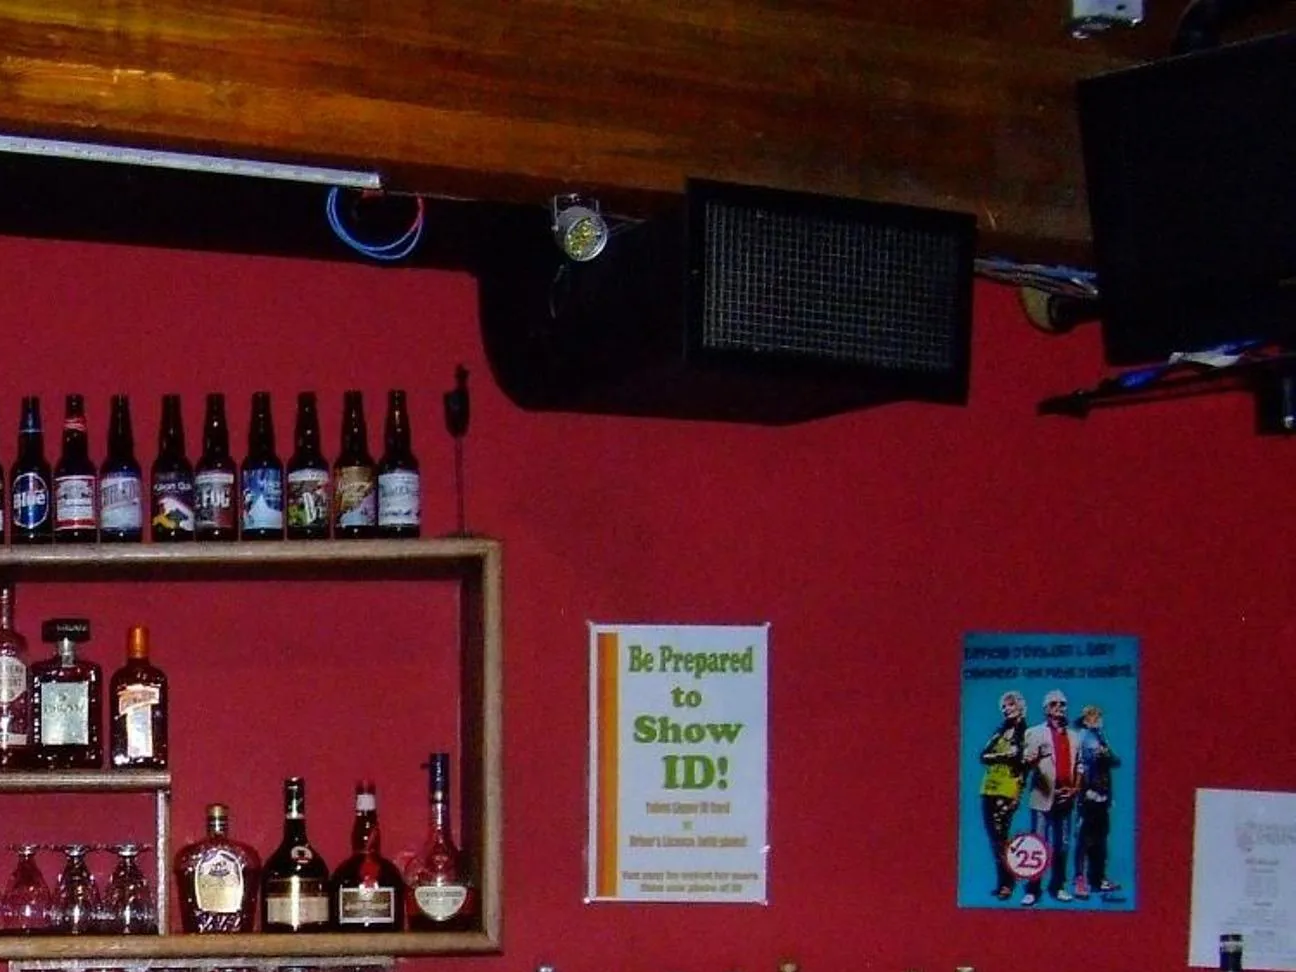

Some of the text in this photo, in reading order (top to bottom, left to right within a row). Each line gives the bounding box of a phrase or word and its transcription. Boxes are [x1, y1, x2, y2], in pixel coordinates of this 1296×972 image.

[627, 645, 754, 679] Be Prepared
[670, 686, 703, 708] to
[633, 715, 744, 744] Show
[661, 754, 729, 790] ID!
[1018, 850, 1043, 868] 25
